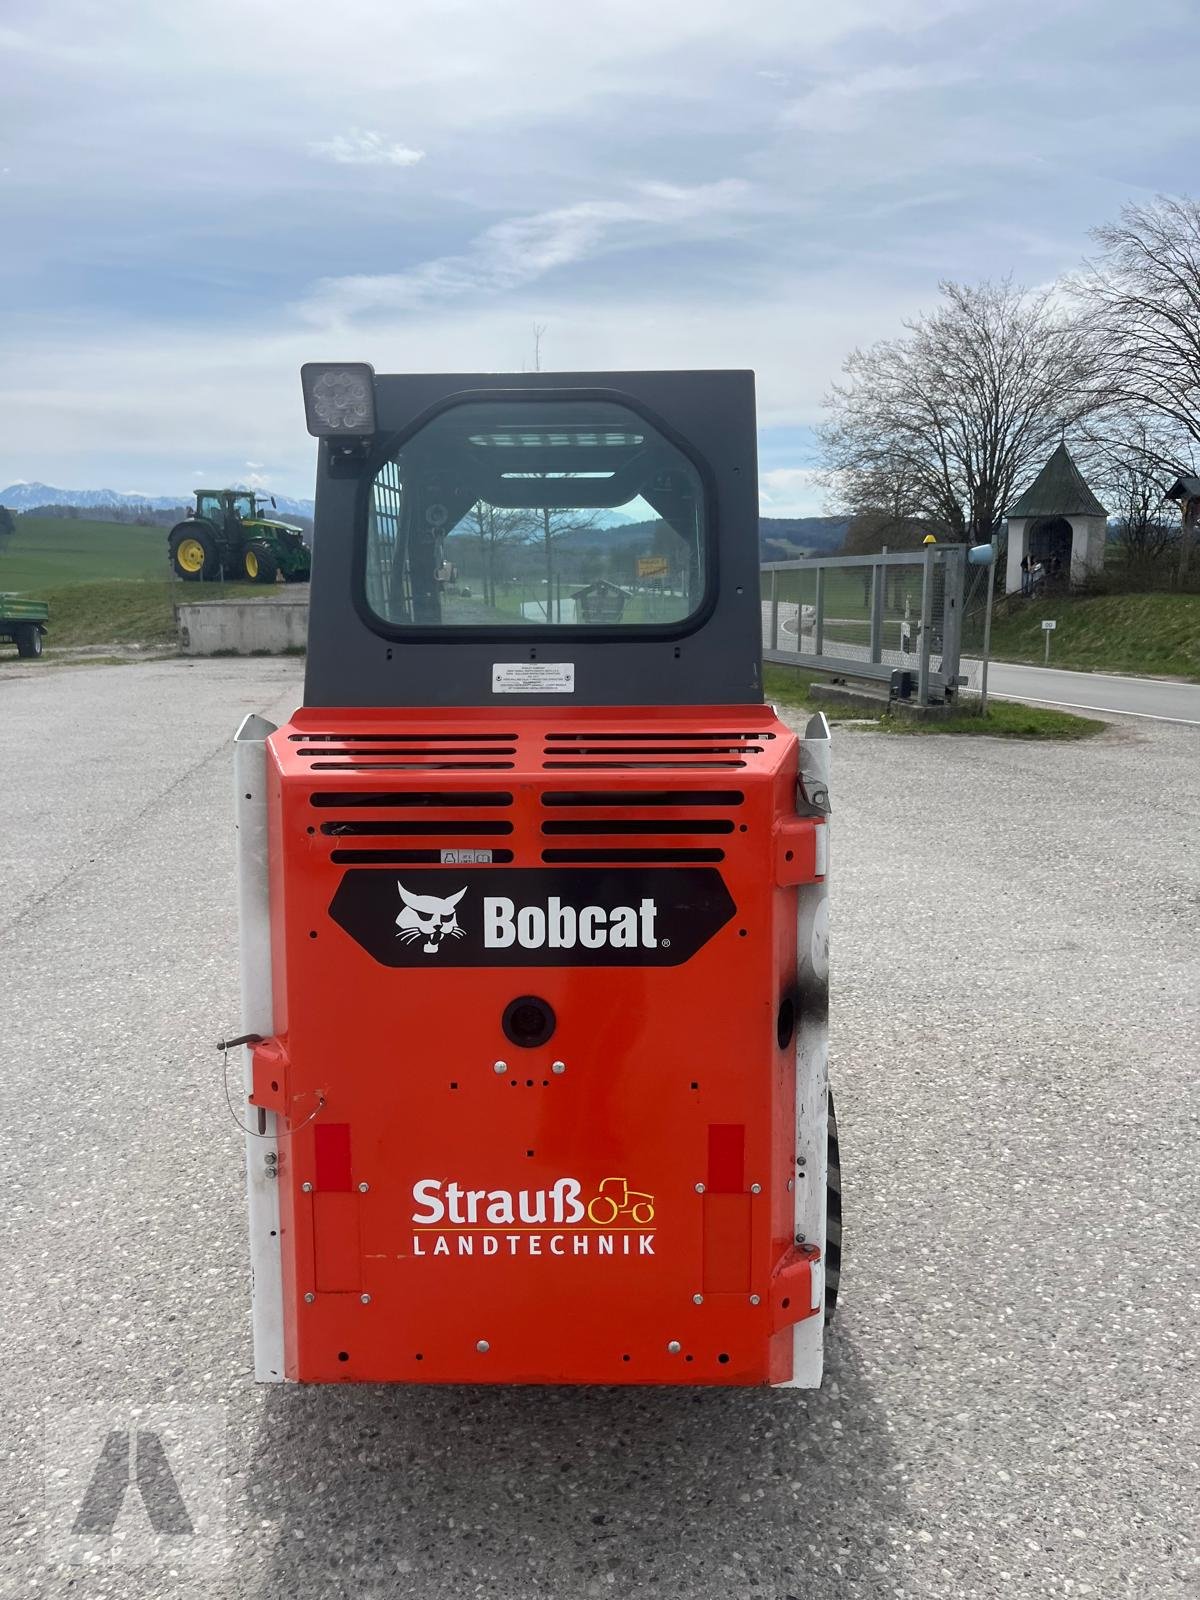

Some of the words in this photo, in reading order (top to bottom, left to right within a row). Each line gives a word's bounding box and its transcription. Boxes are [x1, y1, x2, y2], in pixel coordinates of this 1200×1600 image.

[483, 897, 658, 949] Bobcat
[411, 1177, 585, 1224] Strauß
[413, 1235, 655, 1255] LANDTECHNIK
